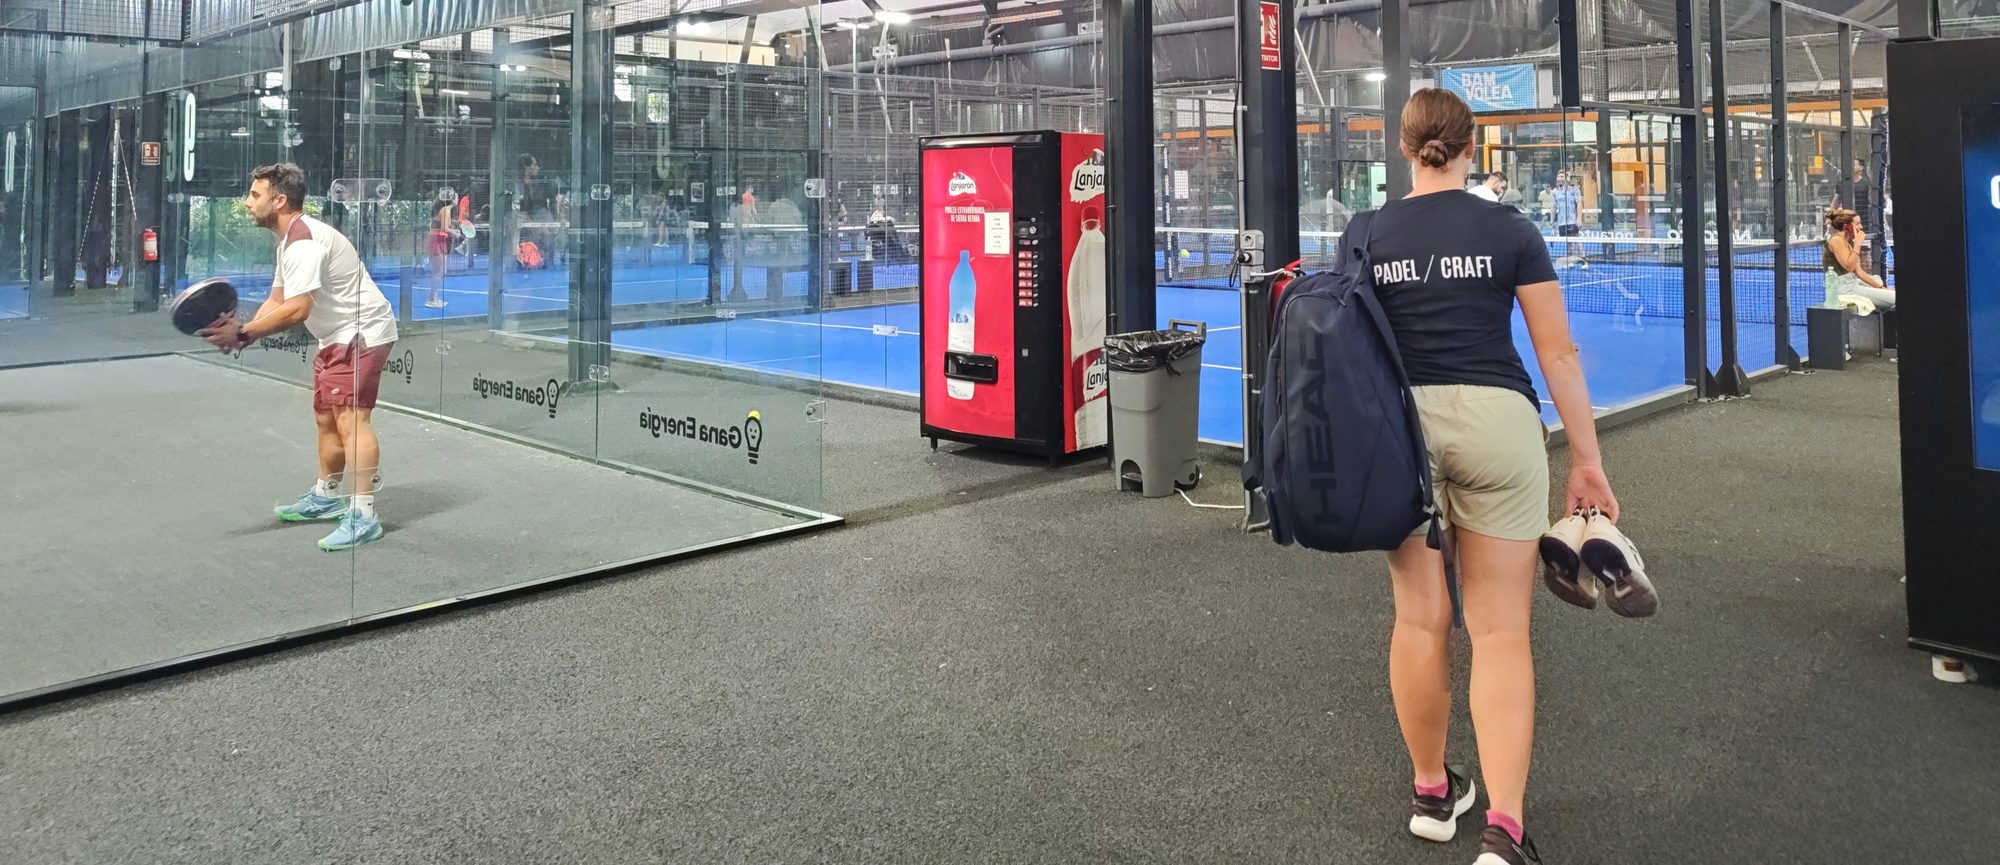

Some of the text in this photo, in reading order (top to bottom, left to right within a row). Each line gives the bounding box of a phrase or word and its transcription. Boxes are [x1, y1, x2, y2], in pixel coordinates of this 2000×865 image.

[1461, 71, 1497, 87] BAM
[1464, 84, 1514, 101] VOLEA
[1373, 259, 1420, 286] PADEL
[1440, 255, 1493, 279] CRAFT
